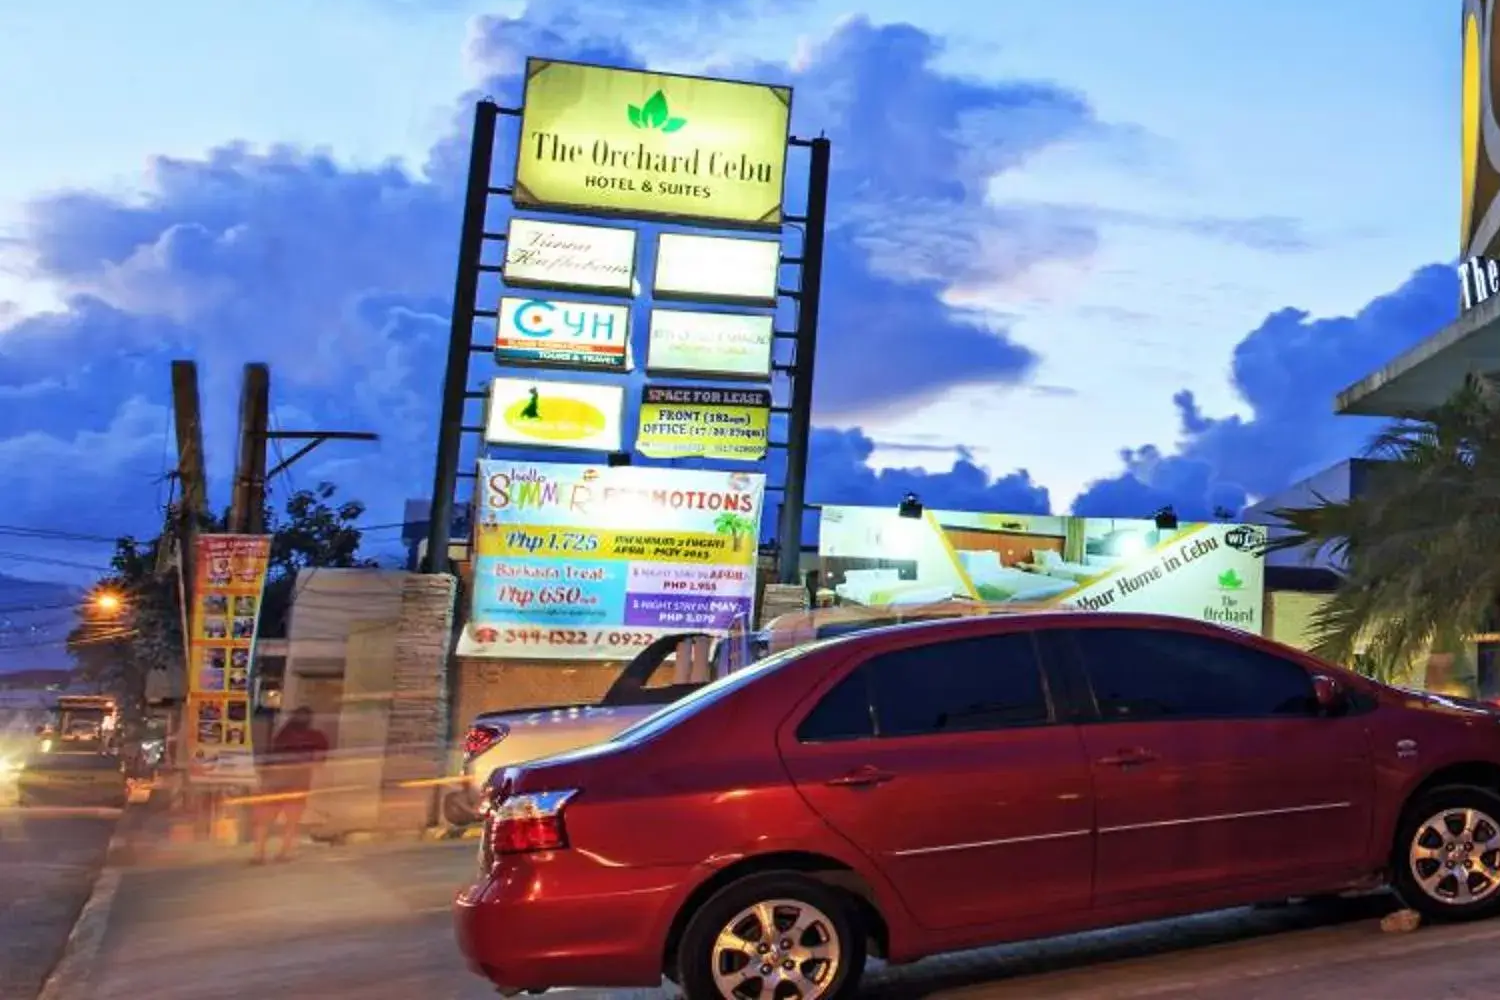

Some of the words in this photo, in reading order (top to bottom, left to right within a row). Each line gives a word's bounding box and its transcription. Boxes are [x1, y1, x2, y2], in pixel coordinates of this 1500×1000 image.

[531, 131, 583, 163] The
[592, 139, 700, 175] Orchard
[708, 150, 772, 183] Cebu
[585, 175, 636, 191] HOTEL
[641, 179, 653, 192] &
[658, 183, 711, 199] SUITES
[1458, 256, 1499, 310] The
[649, 389, 691, 402] SPACE
[693, 390, 721, 403] FOR
[723, 391, 763, 404] LEASE
[659, 409, 700, 421] FRONT
[643, 423, 688, 436] OFFICE
[506, 530, 544, 552] Php
[566, 565, 605, 581] Treat
[1116, 566, 1162, 597] Home
[1161, 554, 1182, 572] in
[1181, 535, 1219, 563] Cebu
[663, 582, 687, 590] PHP
[499, 585, 535, 606] Php
[641, 600, 672, 610] NIGHT
[659, 613, 684, 622] PHP
[1203, 606, 1254, 622] Orchard
